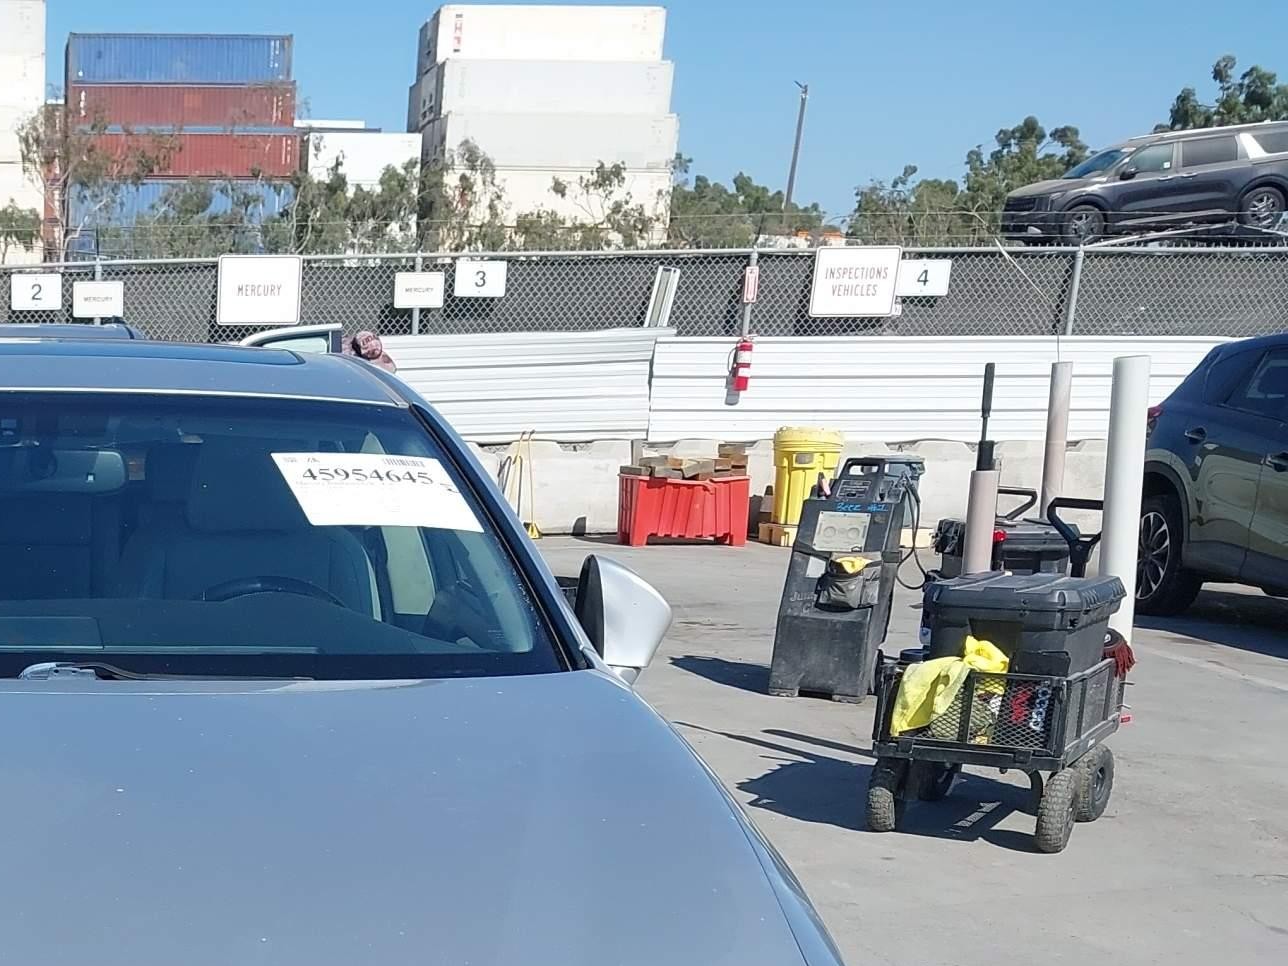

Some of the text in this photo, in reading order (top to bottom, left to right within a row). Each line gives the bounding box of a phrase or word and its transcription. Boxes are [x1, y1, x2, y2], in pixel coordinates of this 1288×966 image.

[474, 270, 487, 288] 3
[824, 266, 889, 280] INSPECTIONS
[916, 269, 929, 287] 4
[31, 283, 43, 301] 2
[237, 284, 282, 297] MERCURY
[831, 284, 878, 297] VEHICLES
[302, 467, 434, 486] 45954645
